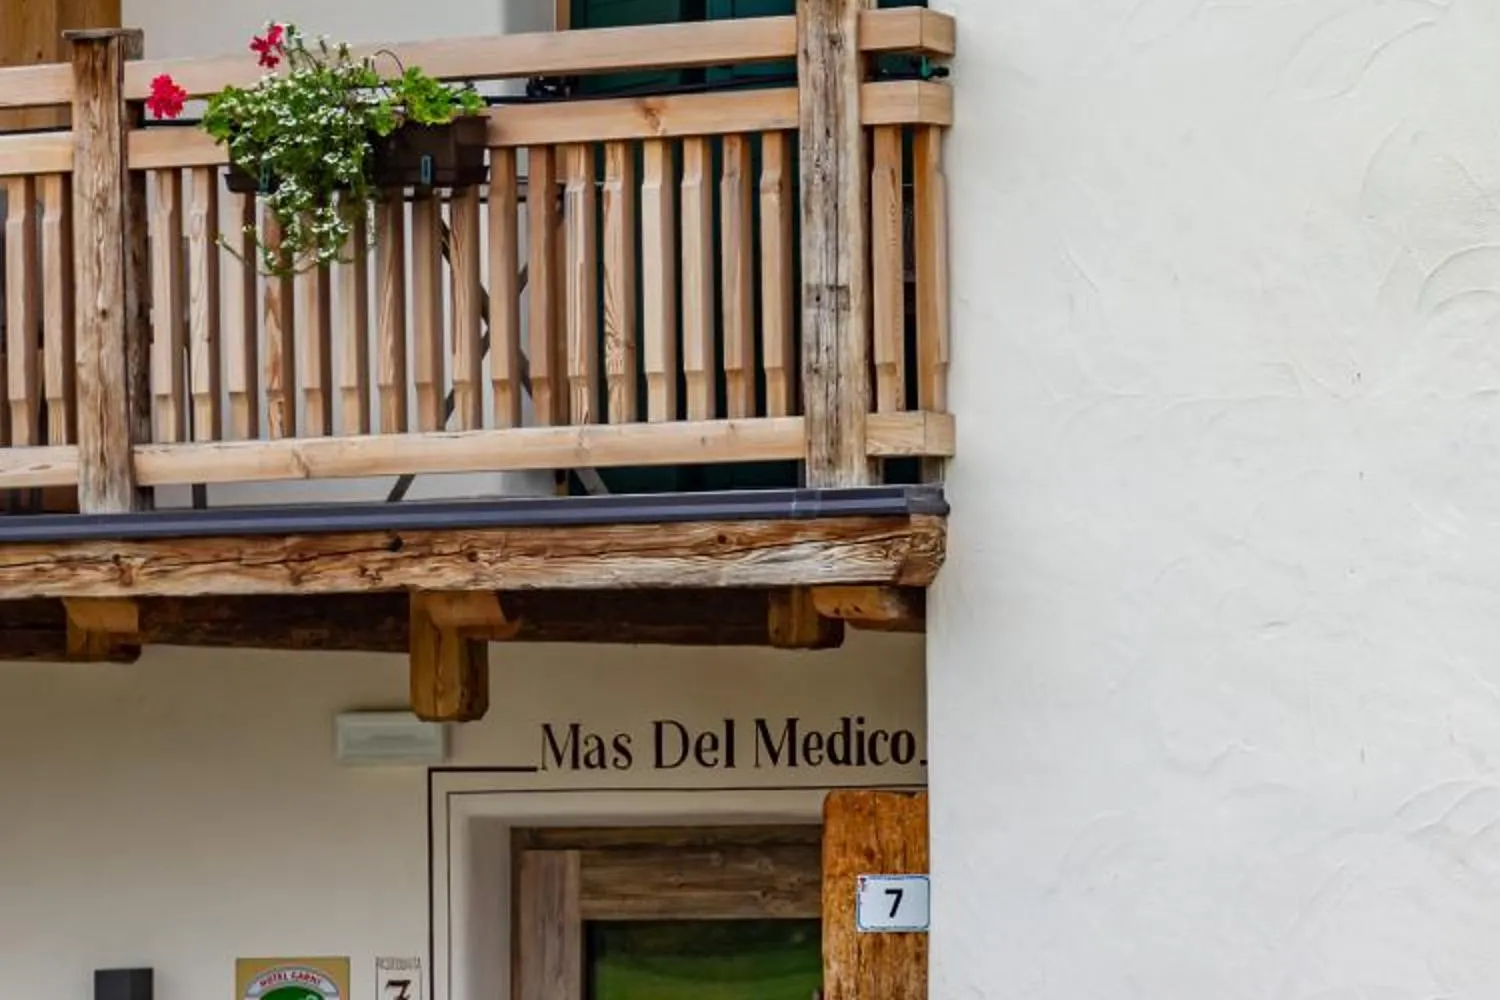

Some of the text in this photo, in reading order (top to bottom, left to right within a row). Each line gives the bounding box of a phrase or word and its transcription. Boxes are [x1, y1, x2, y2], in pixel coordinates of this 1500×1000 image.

[540, 714, 917, 771] Mas Del Medico
[884, 888, 903, 919] 7
